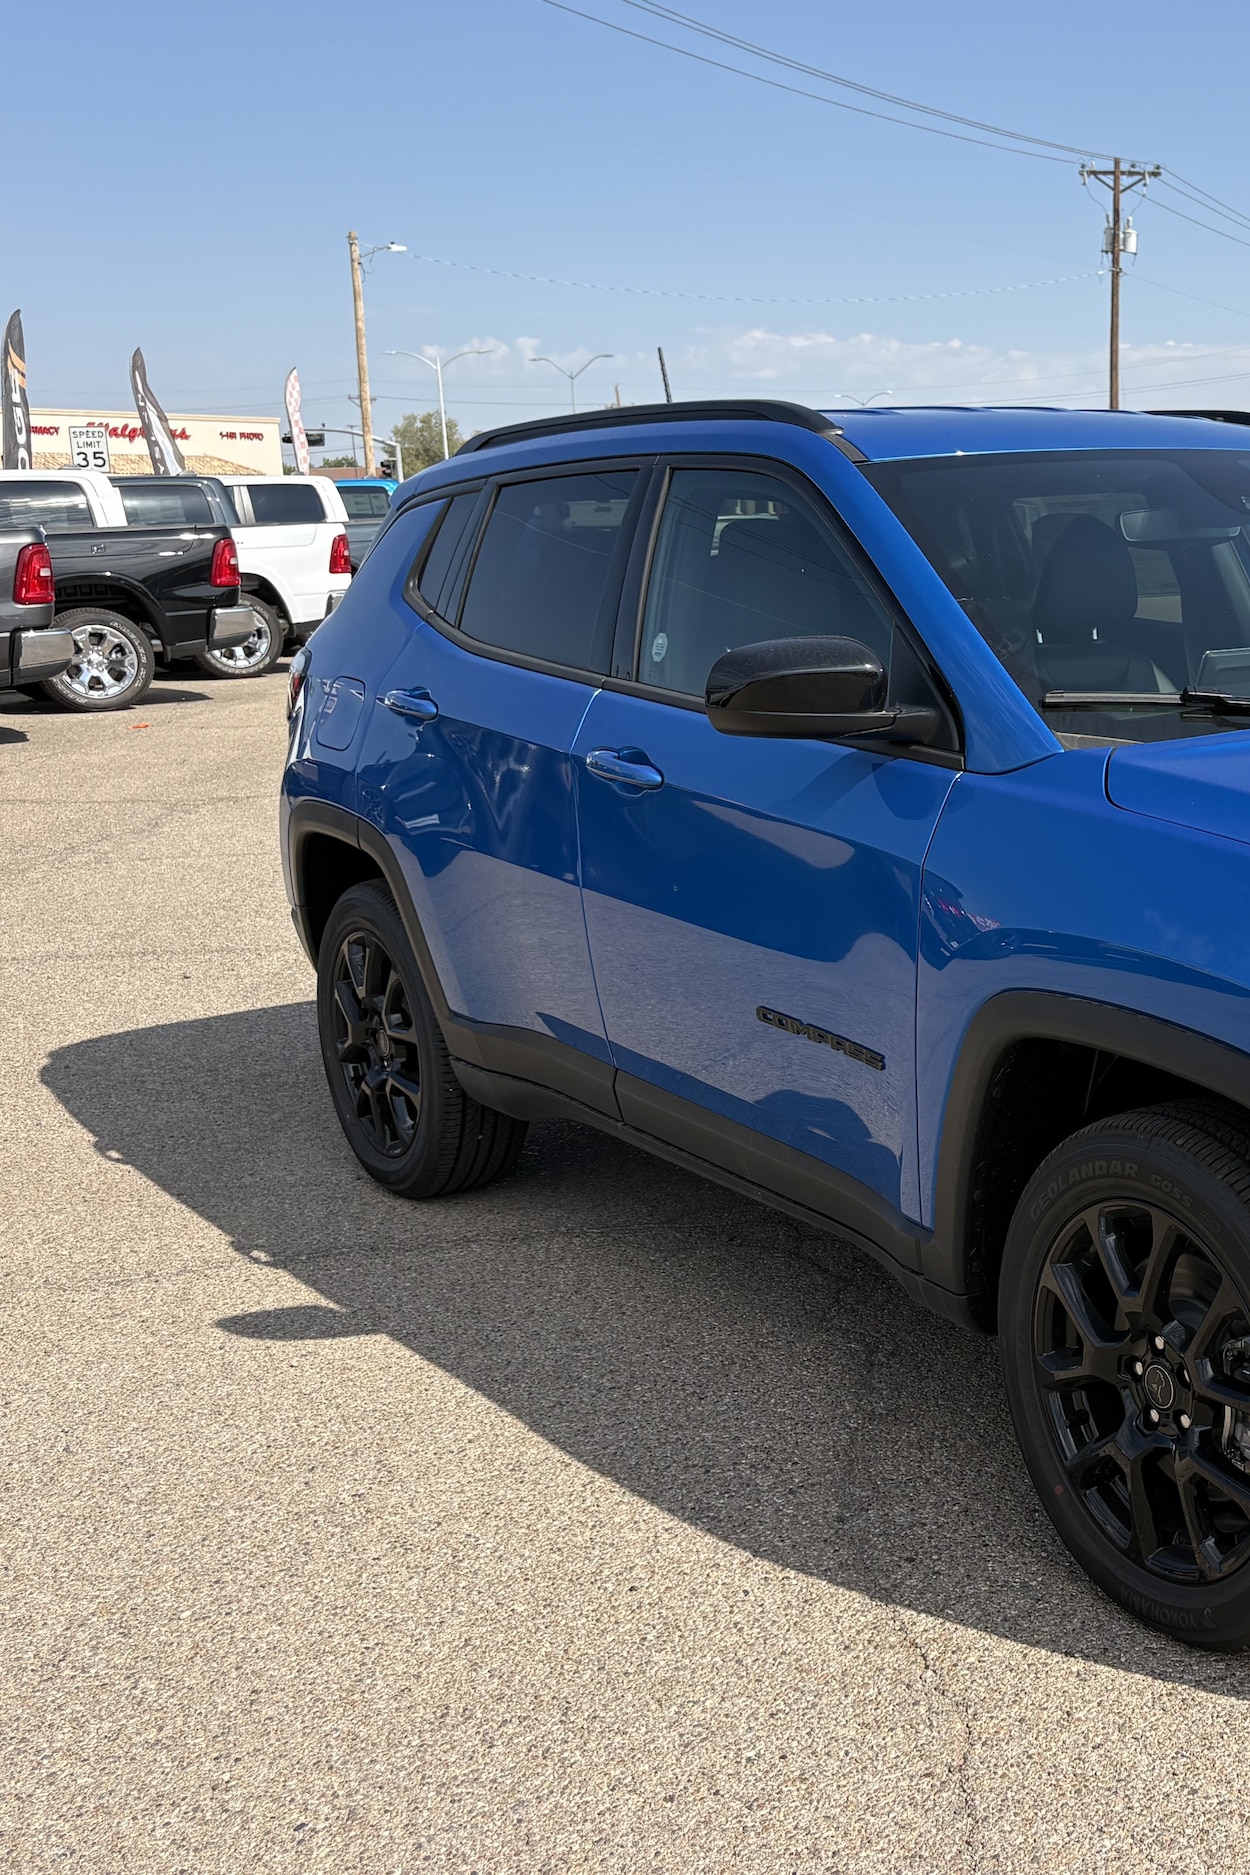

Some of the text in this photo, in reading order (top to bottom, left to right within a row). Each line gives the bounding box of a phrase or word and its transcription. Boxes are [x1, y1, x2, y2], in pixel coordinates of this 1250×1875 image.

[72, 430, 104, 439] SPEED
[76, 440, 101, 449] LIMIT
[76, 451, 106, 468] 35
[756, 1005, 886, 1072] COMPASS
[1029, 1159, 1140, 1223] GEOLANDAR
[1120, 1585, 1199, 1630] YOKOHAMA
